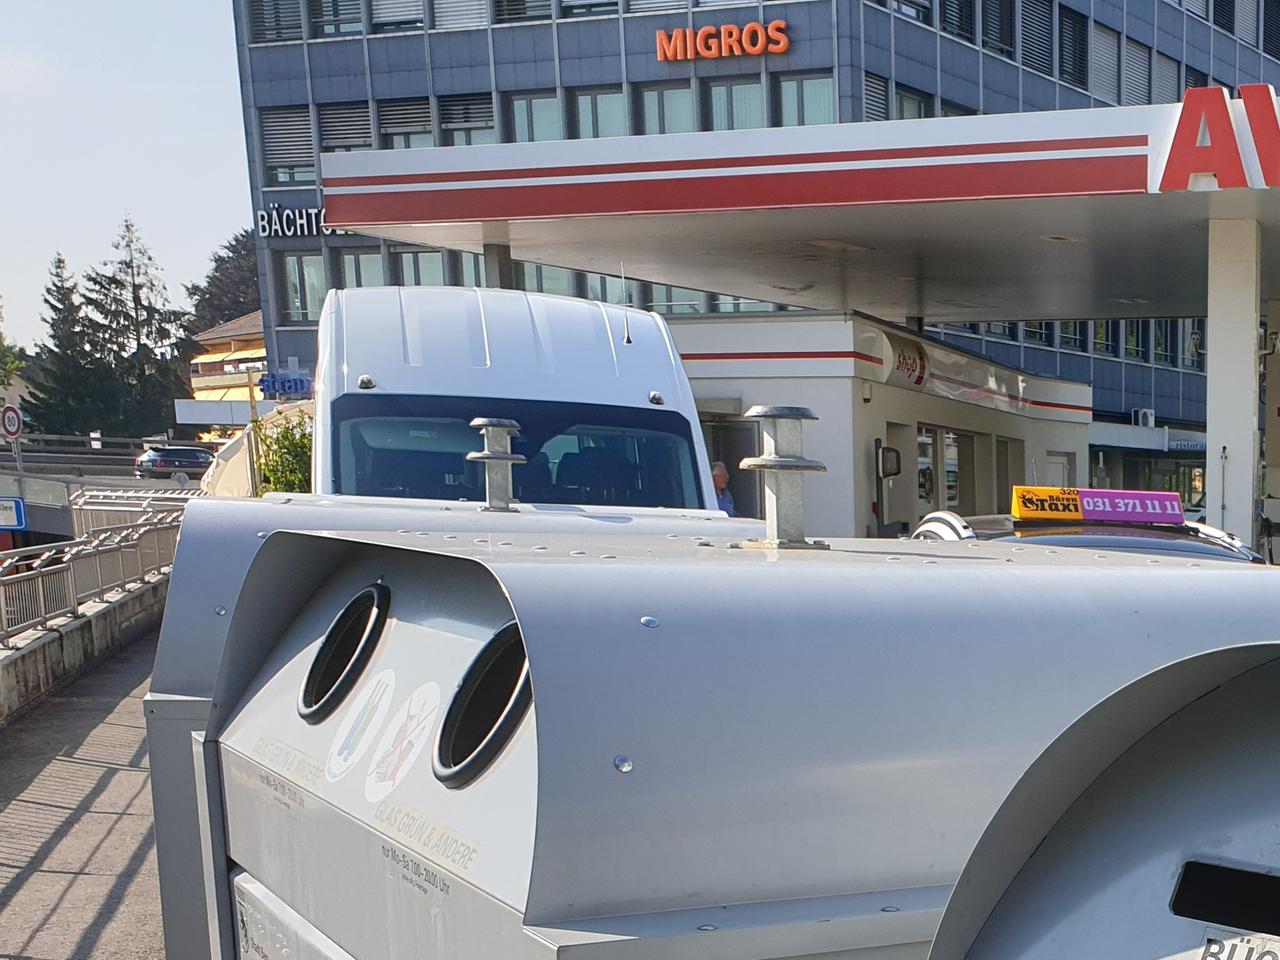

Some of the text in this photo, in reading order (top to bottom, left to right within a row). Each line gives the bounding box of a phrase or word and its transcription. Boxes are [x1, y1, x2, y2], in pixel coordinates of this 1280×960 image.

[656, 19, 791, 62] MIGROS
[1048, 494, 1077, 503] Bären
[1060, 488, 1079, 496] 320
[1037, 499, 1080, 513] Taxi
[1083, 497, 1181, 515] 031 371 11 11
[398, 812, 429, 842] GRÜN
[431, 830, 478, 870] ANDERE
